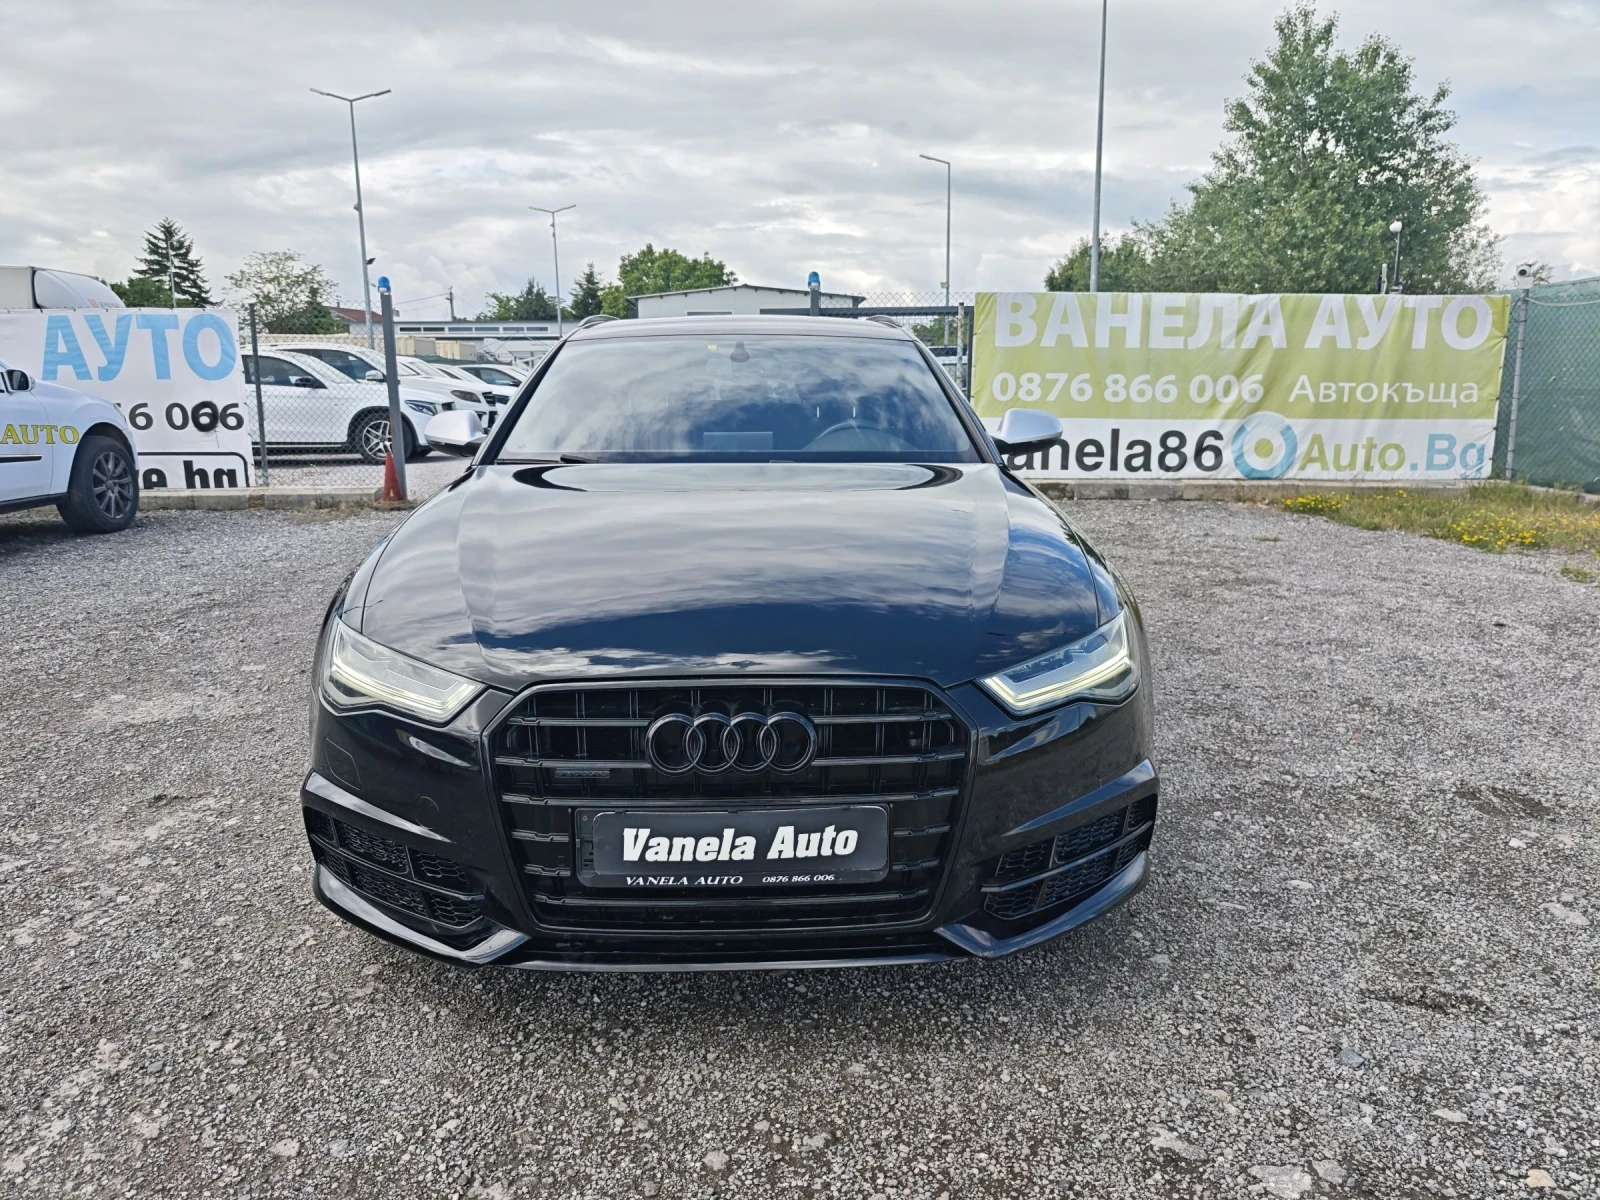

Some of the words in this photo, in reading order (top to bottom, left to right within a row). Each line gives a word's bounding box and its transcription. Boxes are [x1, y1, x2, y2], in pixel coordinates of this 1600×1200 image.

[995, 293, 1287, 349] ВАНЕЛА
[1304, 294, 1493, 350] АУТО
[42, 314, 236, 382] АУТО
[992, 372, 1093, 401] 0876
[1104, 374, 1178, 403] 866
[1189, 374, 1264, 403] 006
[1288, 375, 1479, 408] Автокъща
[0, 423, 80, 444] AUTO
[997, 428, 1224, 473] anela86
[623, 828, 757, 862] Vanela
[766, 824, 859, 860] Auto
[625, 876, 689, 886] VANELA
[694, 875, 744, 885] AUTO
[762, 875, 789, 883] 0876
[791, 874, 811, 882] 866
[813, 874, 835, 882] 006
